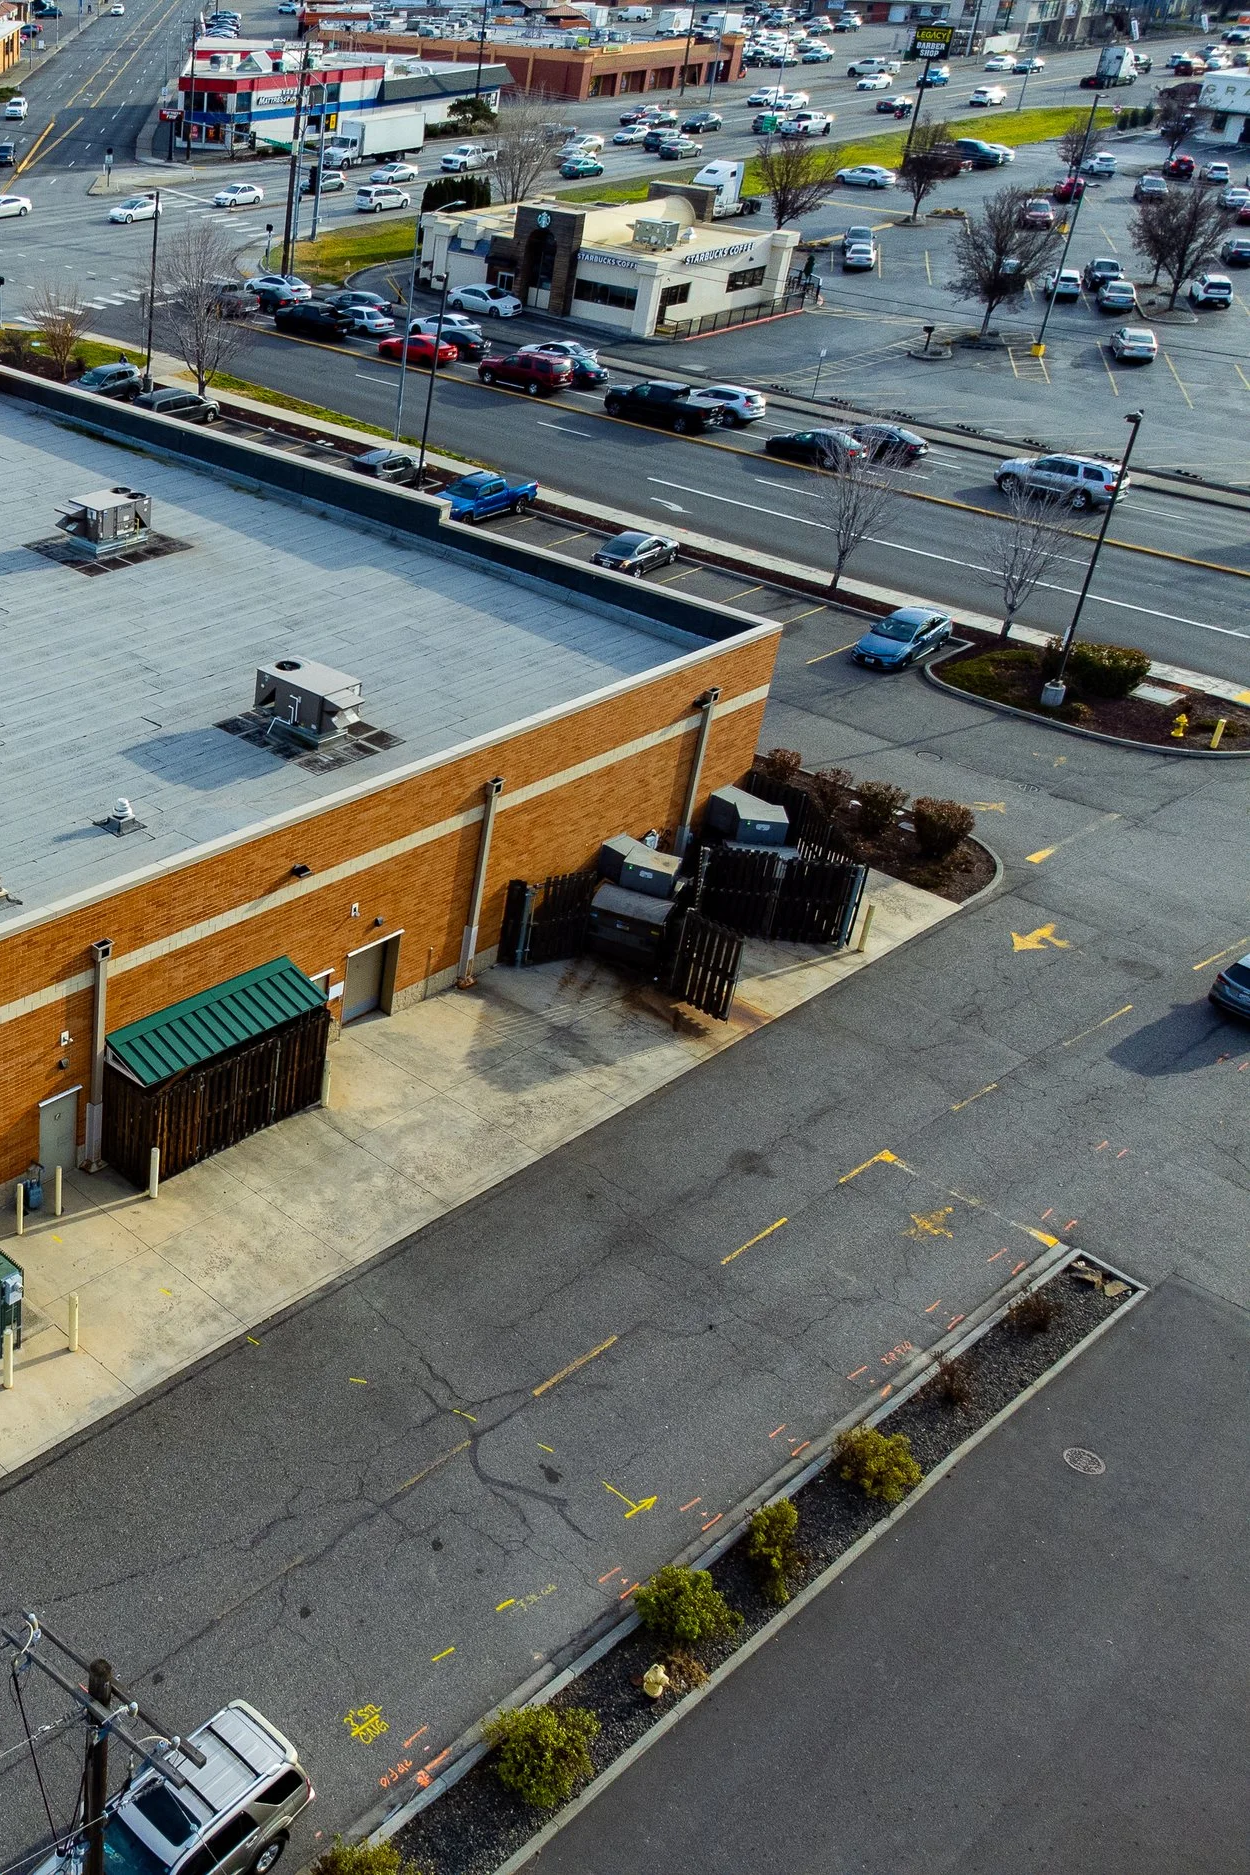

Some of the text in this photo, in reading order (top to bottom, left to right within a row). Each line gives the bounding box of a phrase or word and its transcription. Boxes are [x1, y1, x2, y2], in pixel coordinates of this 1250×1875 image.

[916, 30, 947, 40] LEGACY
[916, 41, 946, 50] BARBER
[919, 49, 940, 57] SHOP
[577, 252, 616, 266] STARBUCKS
[686, 247, 729, 265] STARBUCKS
[358, 1719, 390, 1744] CNG
